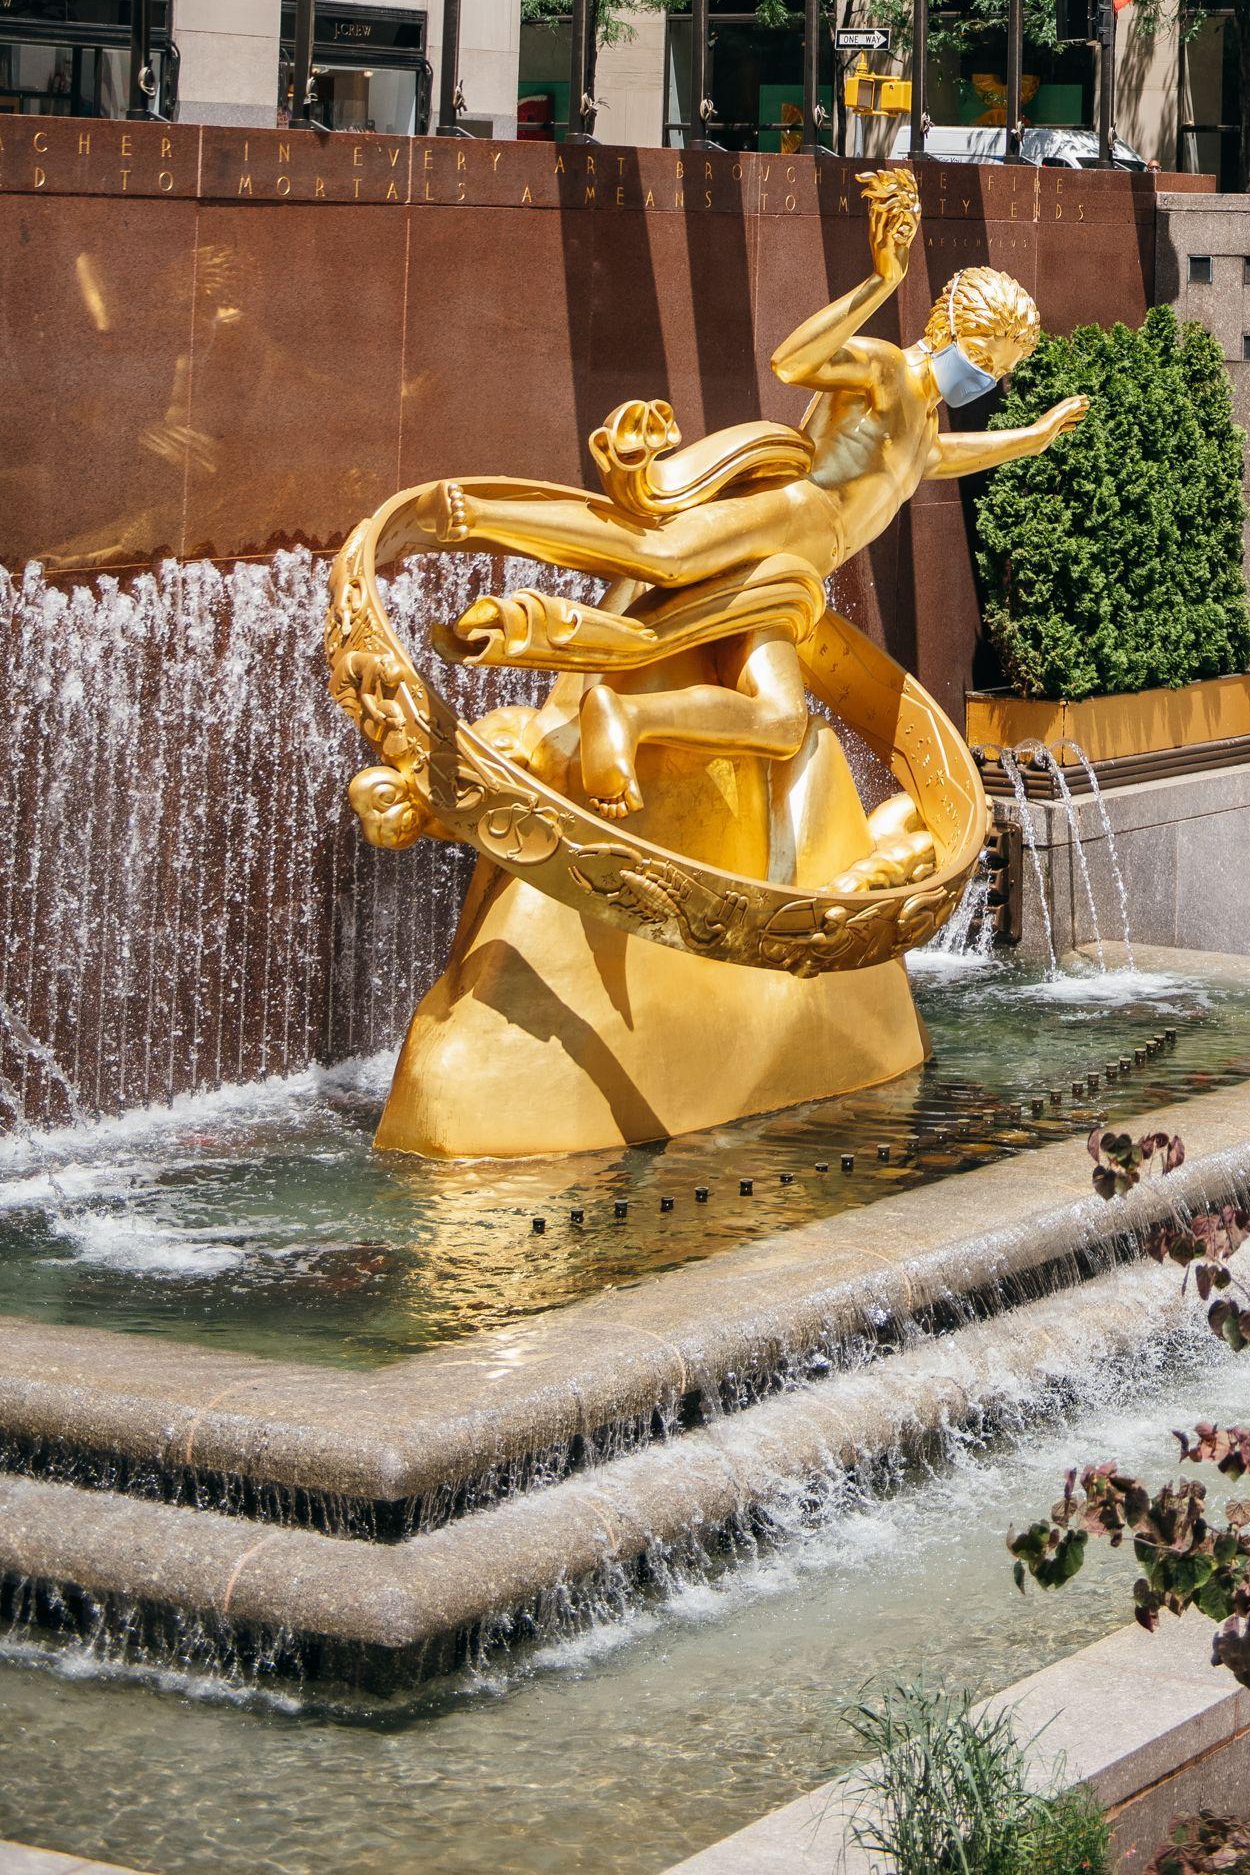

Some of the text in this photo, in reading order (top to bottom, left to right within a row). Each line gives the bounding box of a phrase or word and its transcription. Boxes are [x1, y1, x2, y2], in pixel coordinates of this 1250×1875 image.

[334, 23, 371, 39] J.CREW
[843, 35, 883, 44] ONE WAY
[244, 141, 290, 163] IN
[353, 146, 501, 171] EVERY
[554, 156, 625, 175] ART
[676, 160, 848, 185] BROUGHT
[915, 170, 949, 190] HE
[988, 175, 1063, 194] FIRE
[119, 170, 174, 192] TO
[237, 175, 466, 201] MORTALS
[520, 184, 533, 203] A
[584, 187, 712, 208] MEANS
[760, 193, 796, 211] TO
[838, 196, 971, 216] MTY
[1011, 202, 1084, 220] ENDS
[928, 237, 1027, 248] AESCHYLUS
